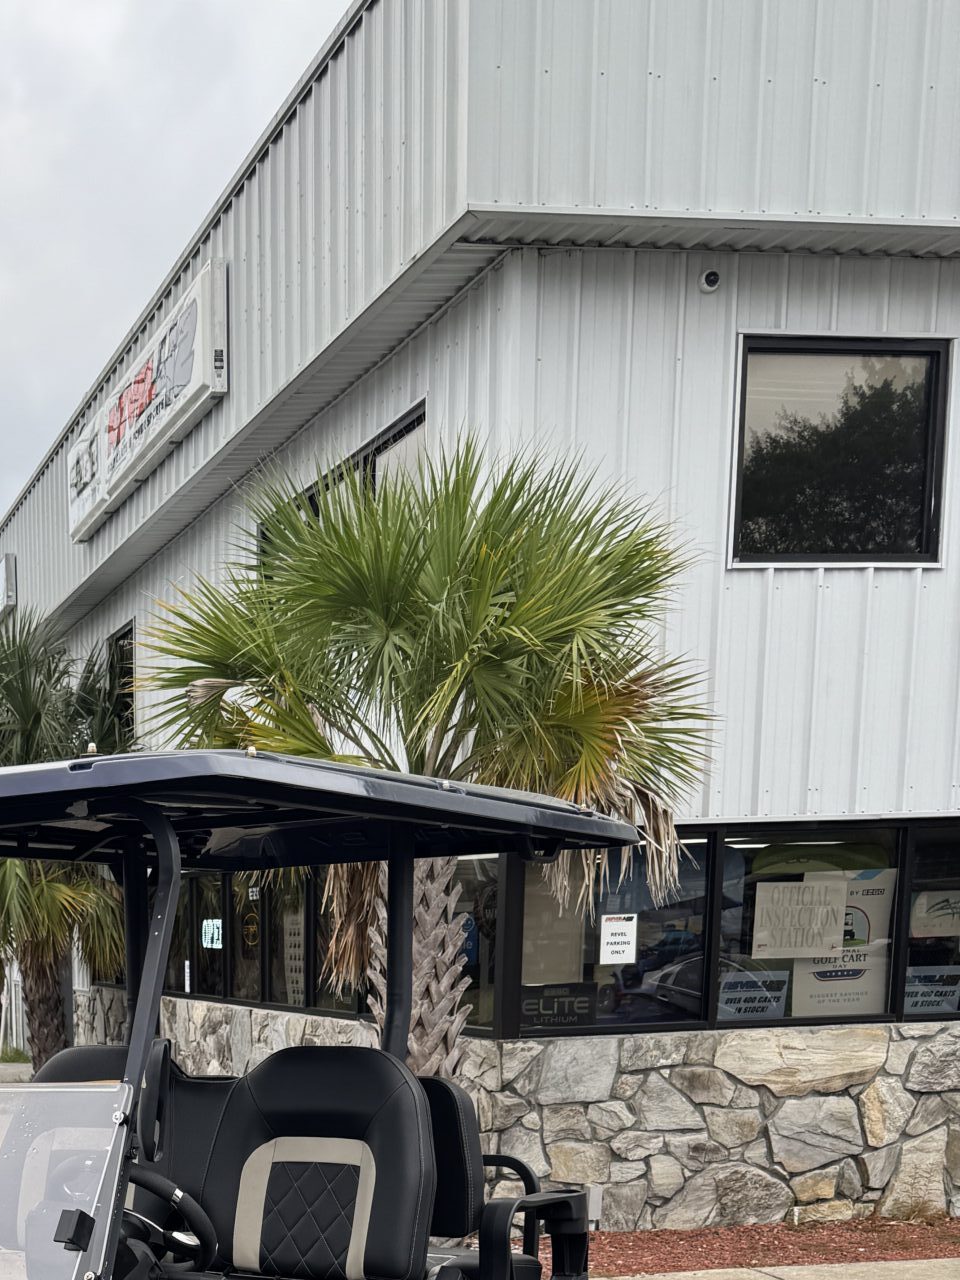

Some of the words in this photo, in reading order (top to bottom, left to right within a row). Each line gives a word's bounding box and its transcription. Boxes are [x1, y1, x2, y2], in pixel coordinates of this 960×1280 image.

[771, 886, 830, 907] OFFICIAL
[760, 906, 839, 928] INSPECTION
[770, 927, 824, 949] STATION
[812, 956, 840, 965] GOLF
[842, 953, 869, 964] CART
[725, 996, 742, 1005] OVER
[757, 996, 781, 1004] CARTS
